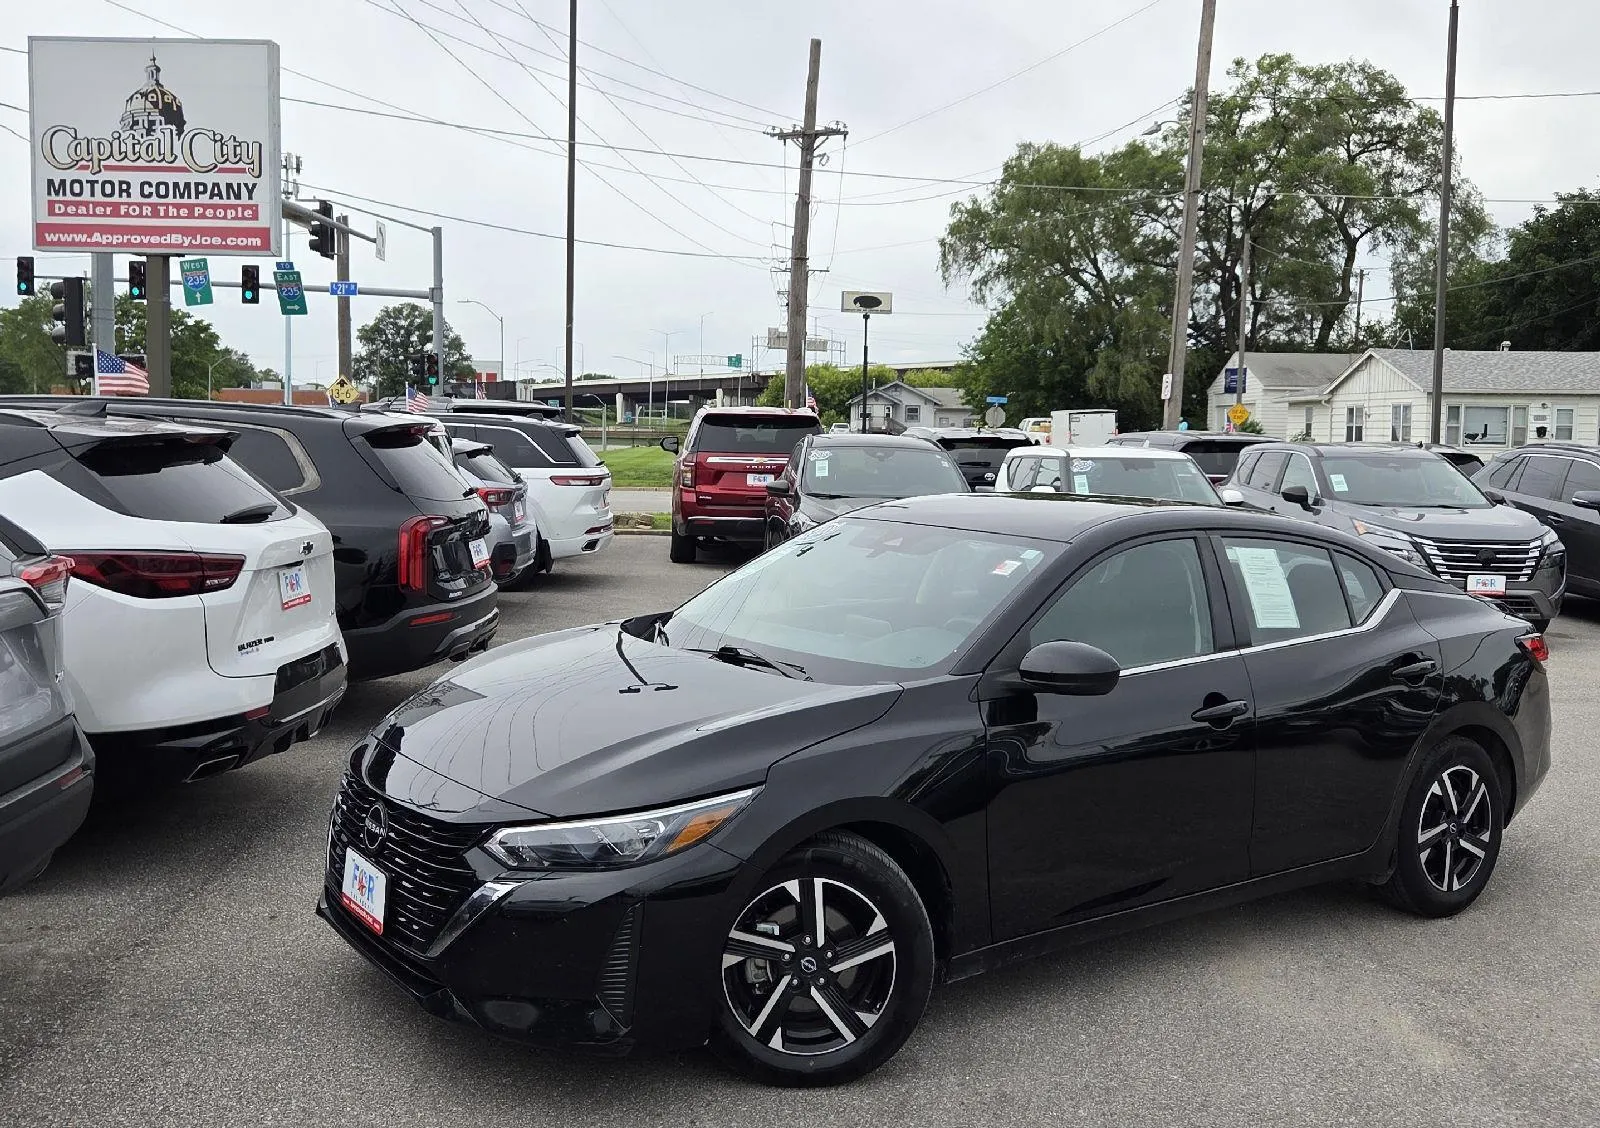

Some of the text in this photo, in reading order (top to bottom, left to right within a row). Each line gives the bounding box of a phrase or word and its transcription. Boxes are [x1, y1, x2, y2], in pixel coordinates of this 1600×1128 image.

[41, 124, 262, 178] Capital City
[46, 178, 259, 201] MOTOR COMPANY
[54, 203, 255, 220] Dealer FOR The People
[44, 230, 263, 247] www.ApprovedByJoe.com
[187, 275, 206, 286] 235
[281, 286, 301, 297] 235
